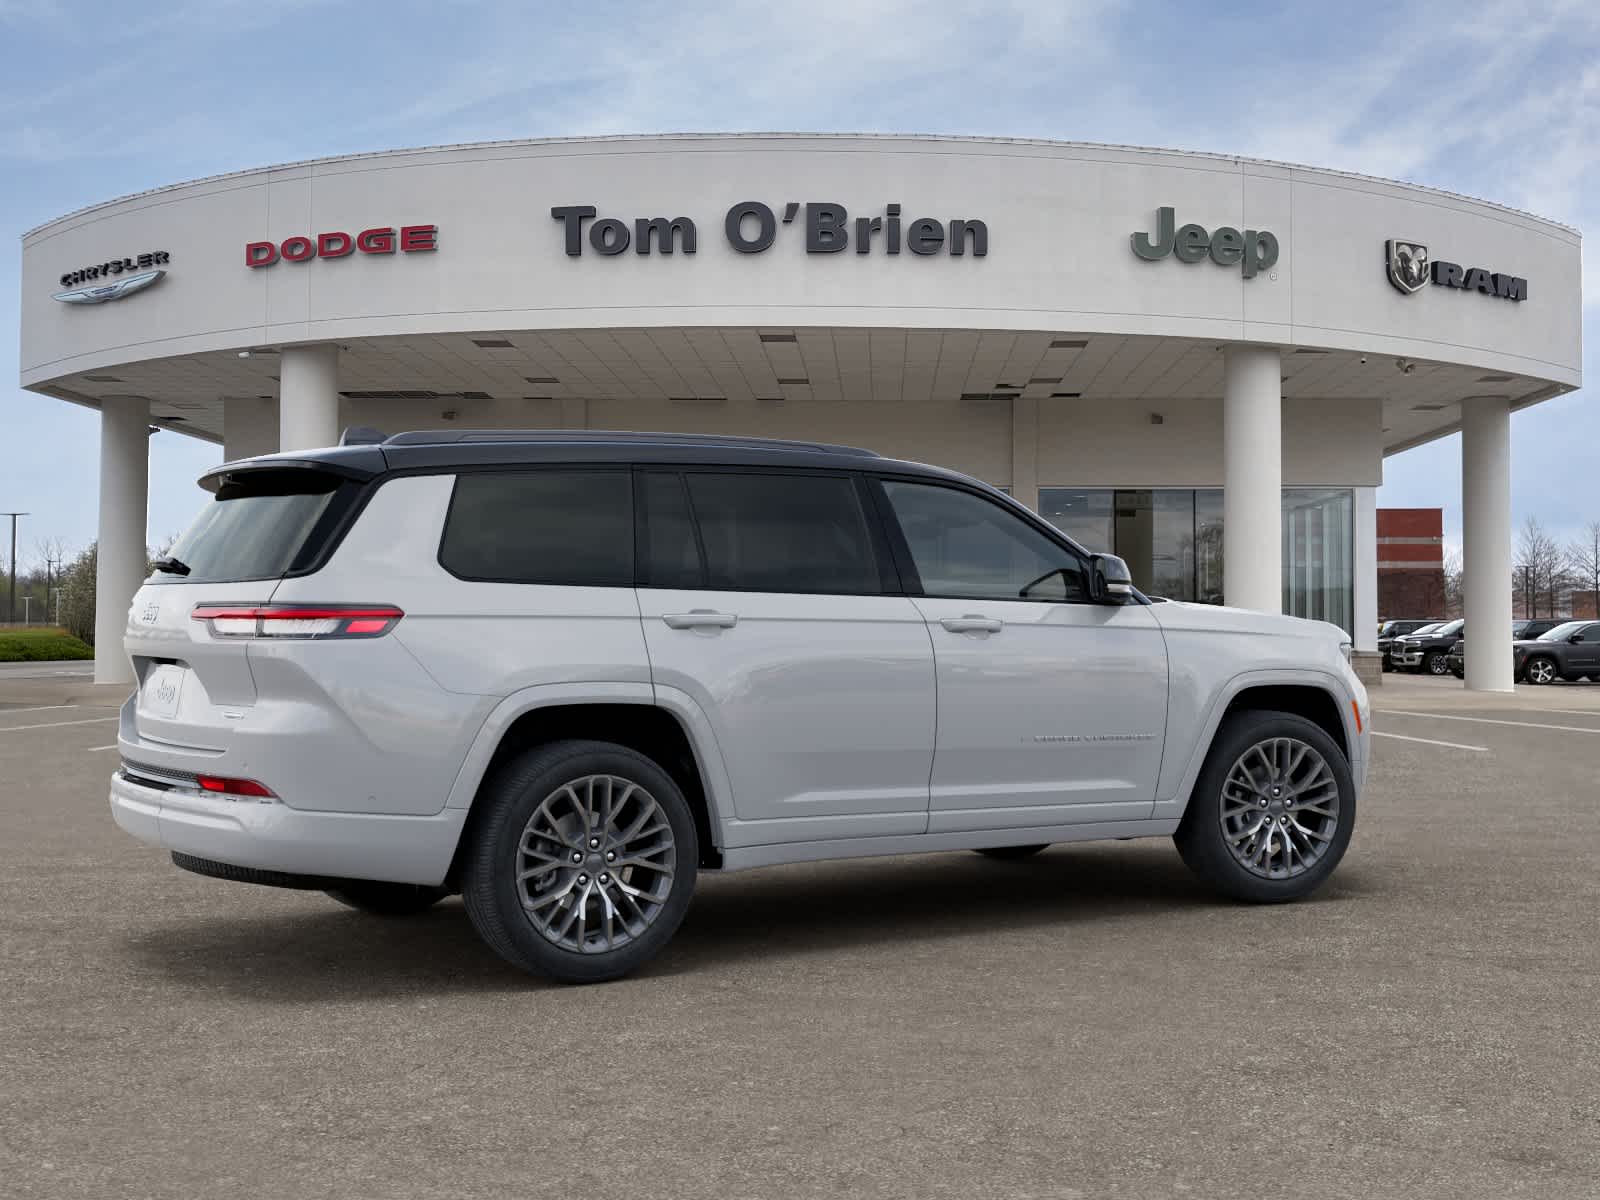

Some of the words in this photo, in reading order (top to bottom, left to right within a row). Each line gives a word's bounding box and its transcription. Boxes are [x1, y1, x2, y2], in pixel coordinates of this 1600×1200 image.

[245, 224, 438, 270] DODGE
[551, 205, 697, 257] Tom
[725, 200, 989, 257] O'Brien
[1130, 206, 1279, 279] Jeep
[60, 250, 170, 287] CHRYSLER
[1431, 260, 1528, 302] RAM
